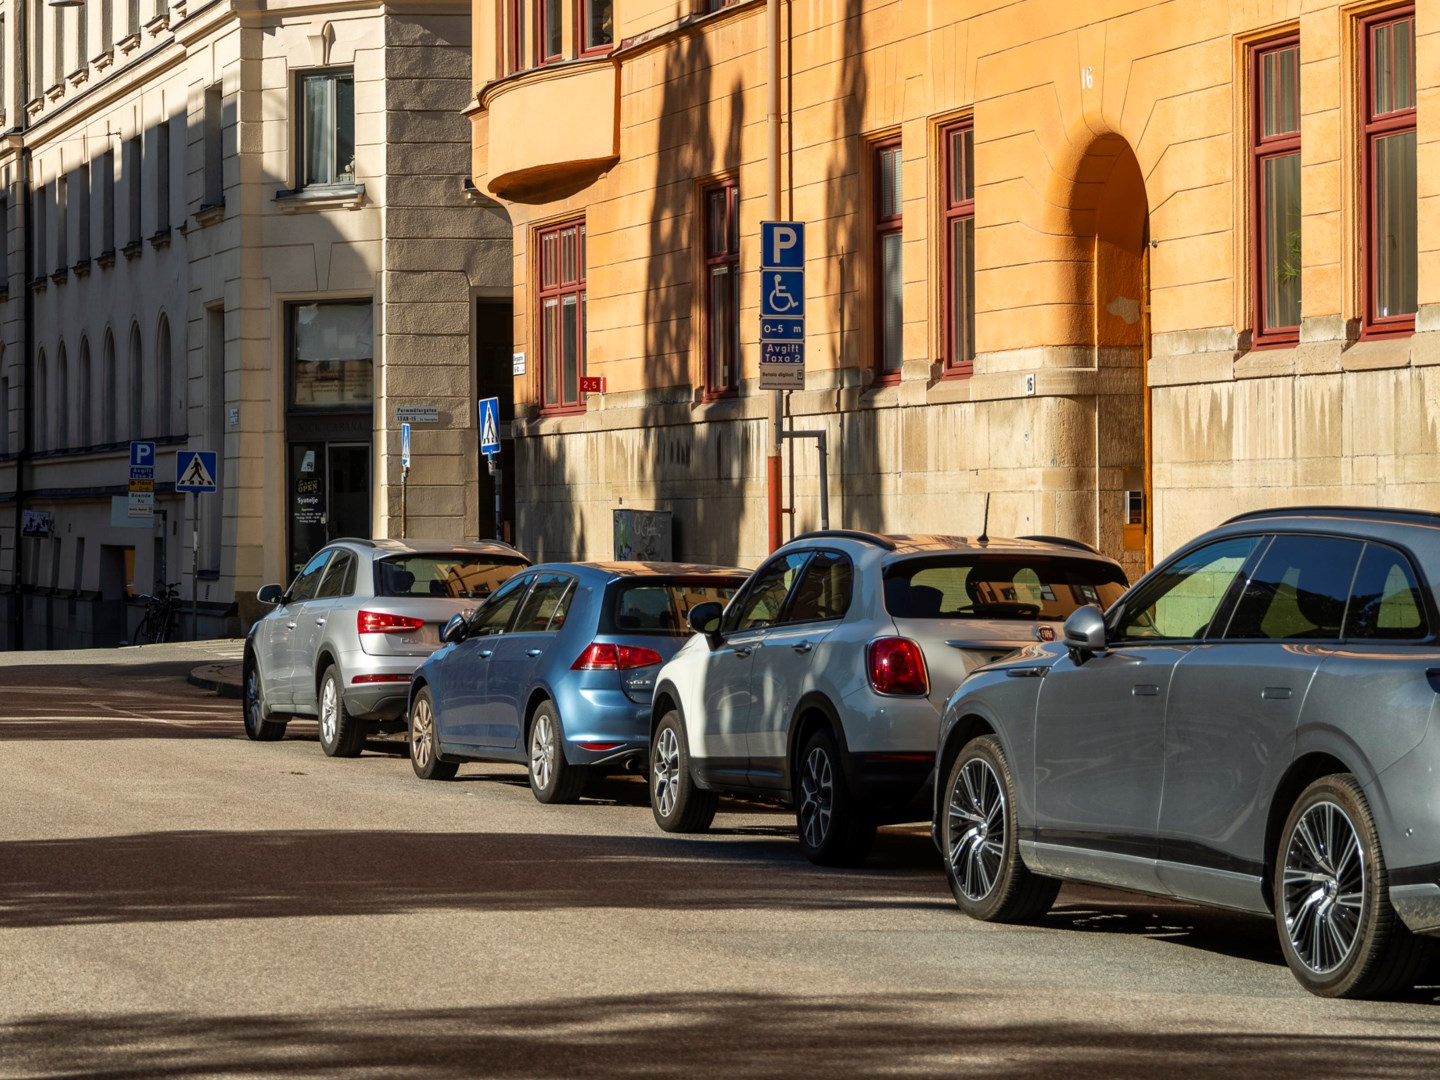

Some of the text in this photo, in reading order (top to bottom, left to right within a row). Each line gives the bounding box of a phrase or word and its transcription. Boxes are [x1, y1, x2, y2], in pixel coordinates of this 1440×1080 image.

[1081, 66, 1093, 89] 16
[773, 226, 797, 264] P
[763, 324, 802, 333] 0-5 m
[767, 343, 799, 354] Avgift
[765, 354, 801, 363] Taxa 2
[137, 444, 151, 464] P
[298, 483, 318, 493] OPEN
